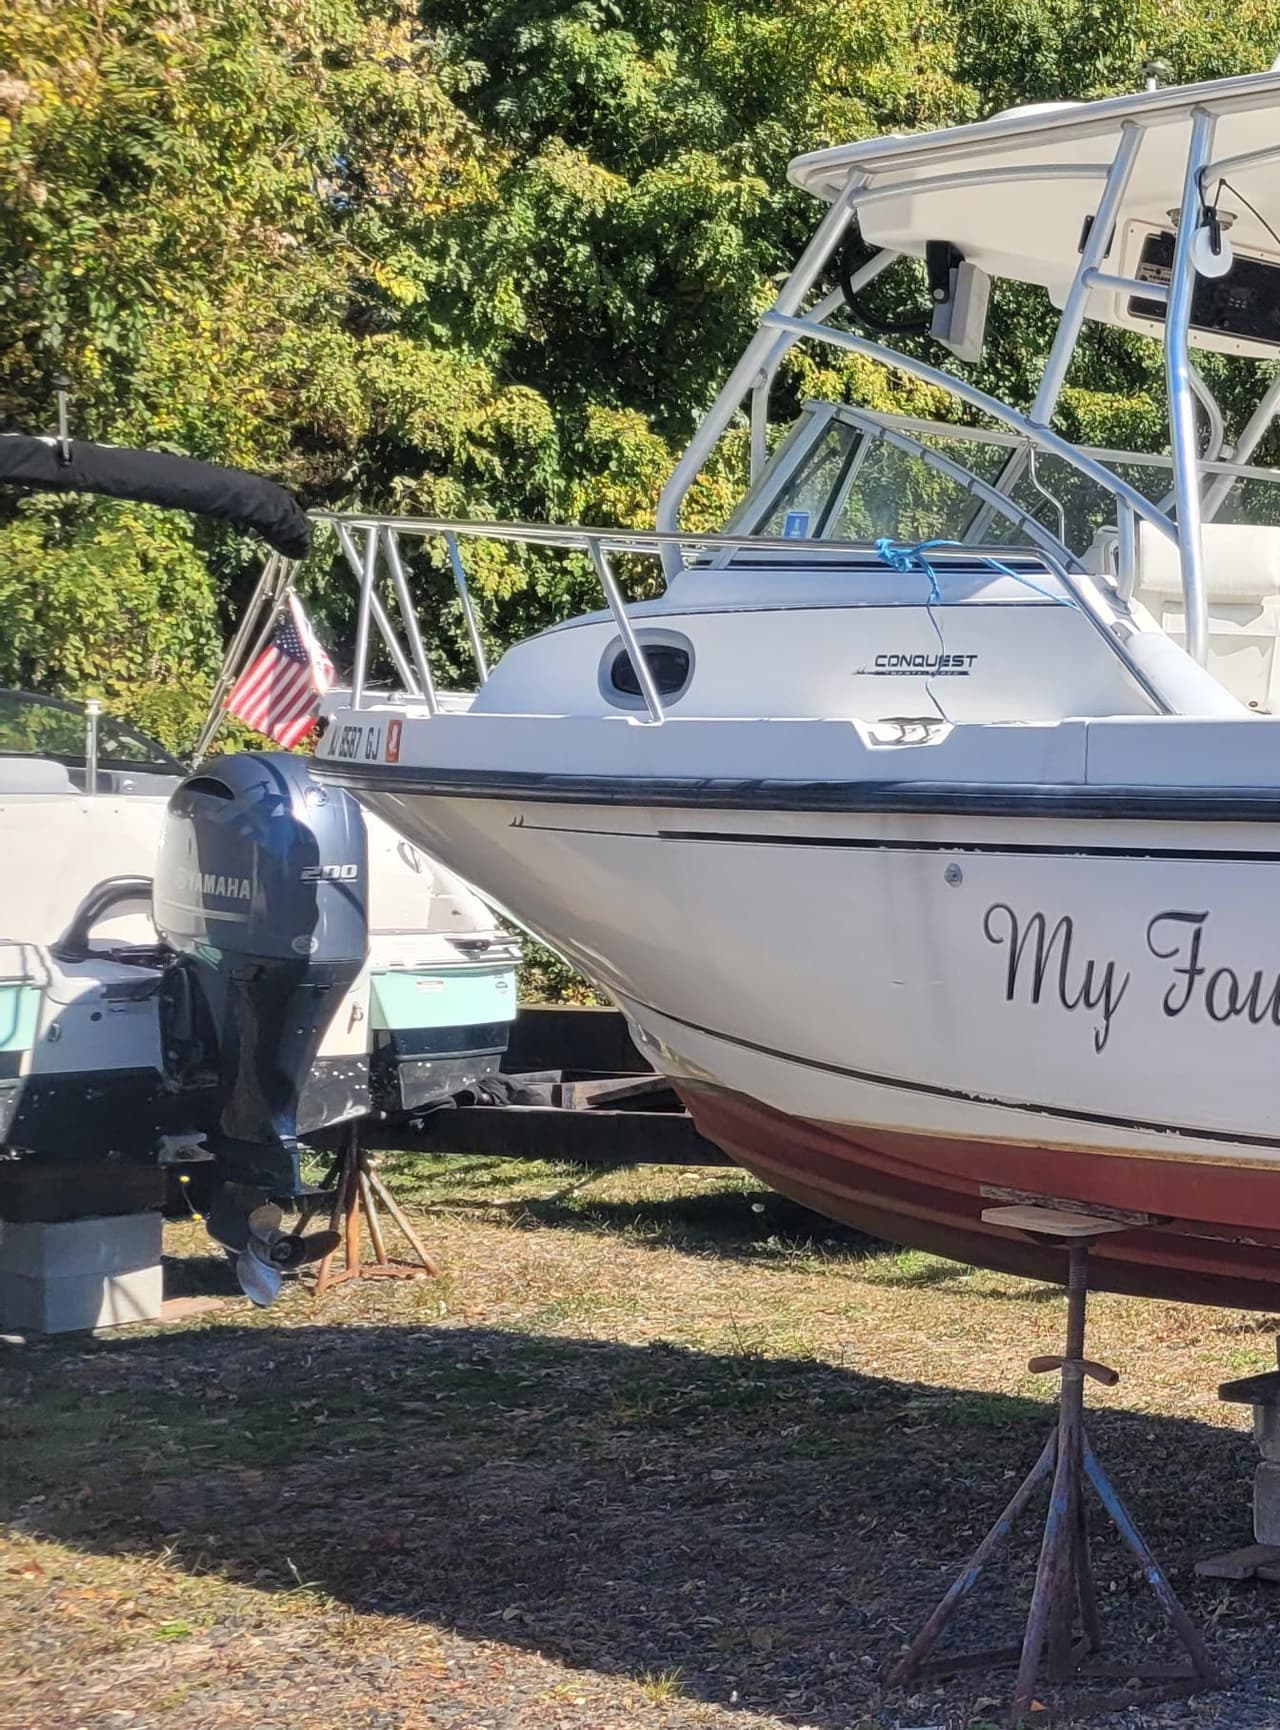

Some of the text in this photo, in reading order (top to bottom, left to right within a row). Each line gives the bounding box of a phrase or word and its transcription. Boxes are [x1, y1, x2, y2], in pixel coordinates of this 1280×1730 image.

[874, 653, 979, 669] CONQUEST
[301, 863, 359, 881] 200
[186, 869, 251, 900] YAMAHA
[982, 903, 1131, 1055] My
